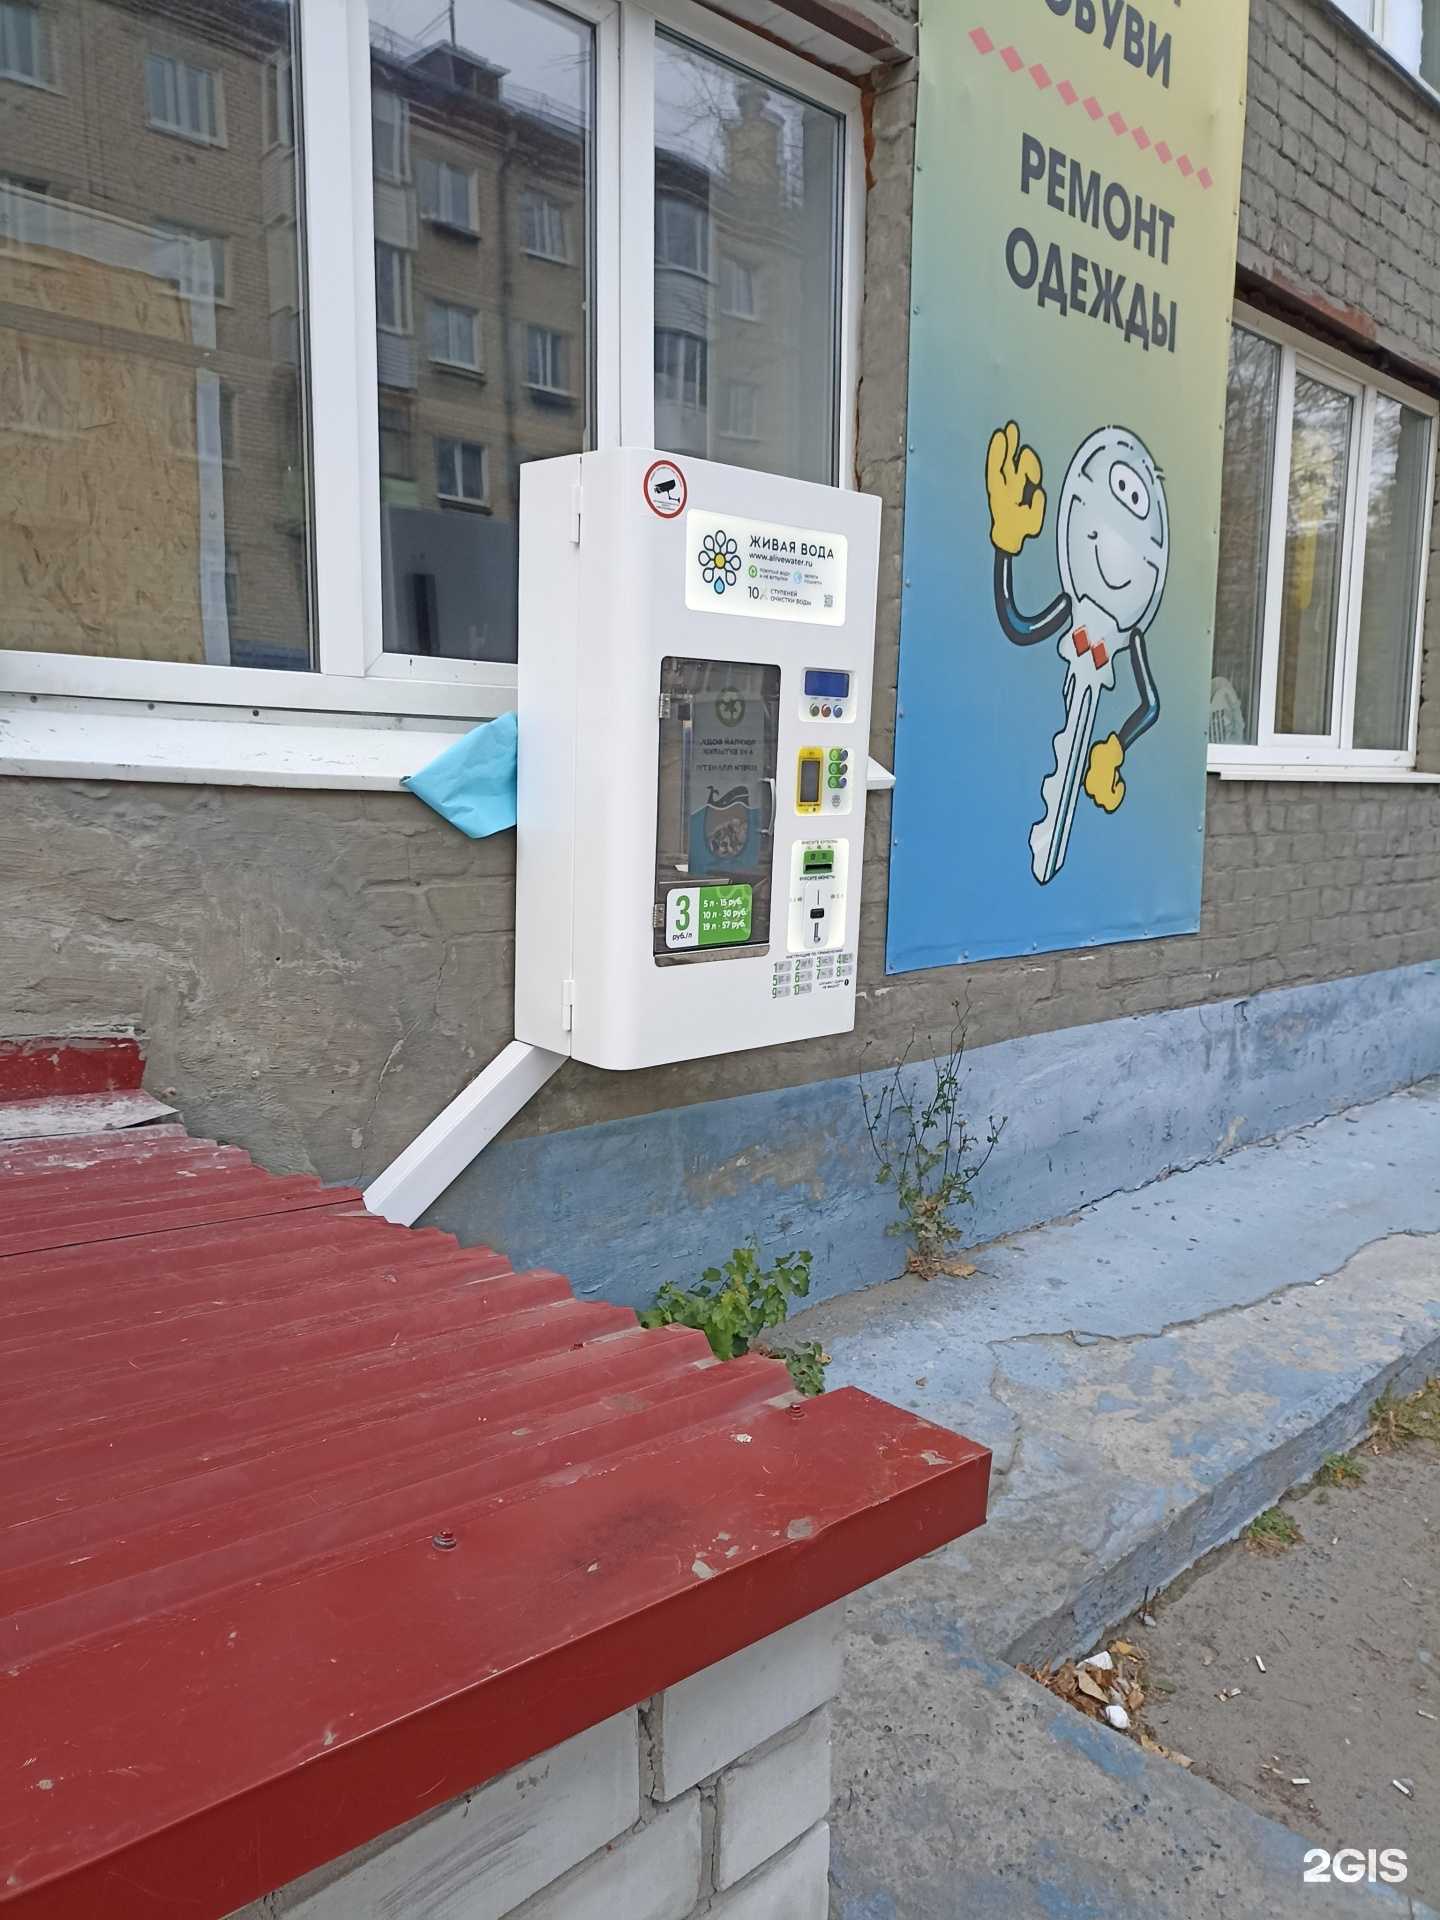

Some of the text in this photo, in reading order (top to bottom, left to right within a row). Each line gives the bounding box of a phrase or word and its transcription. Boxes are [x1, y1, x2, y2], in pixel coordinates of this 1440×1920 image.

[1045, 0, 1172, 89] БУВИ
[1021, 132, 1176, 265] РЕМОНТ
[1005, 227, 1178, 353] ОДЕЖДЫ
[750, 535, 834, 560] ЖИВАЯ ВОДА
[749, 553, 813, 567] www.alivewater.ru
[748, 586, 760, 600] 10
[703, 899, 708, 908] 5
[720, 898, 728, 906] 15
[676, 895, 690, 930] 3
[703, 911, 711, 919] 10
[722, 909, 732, 917] 30
[703, 923, 710, 931] 19
[722, 921, 730, 929] 57
[795, 960, 801, 971] 2
[772, 974, 778, 986] 5
